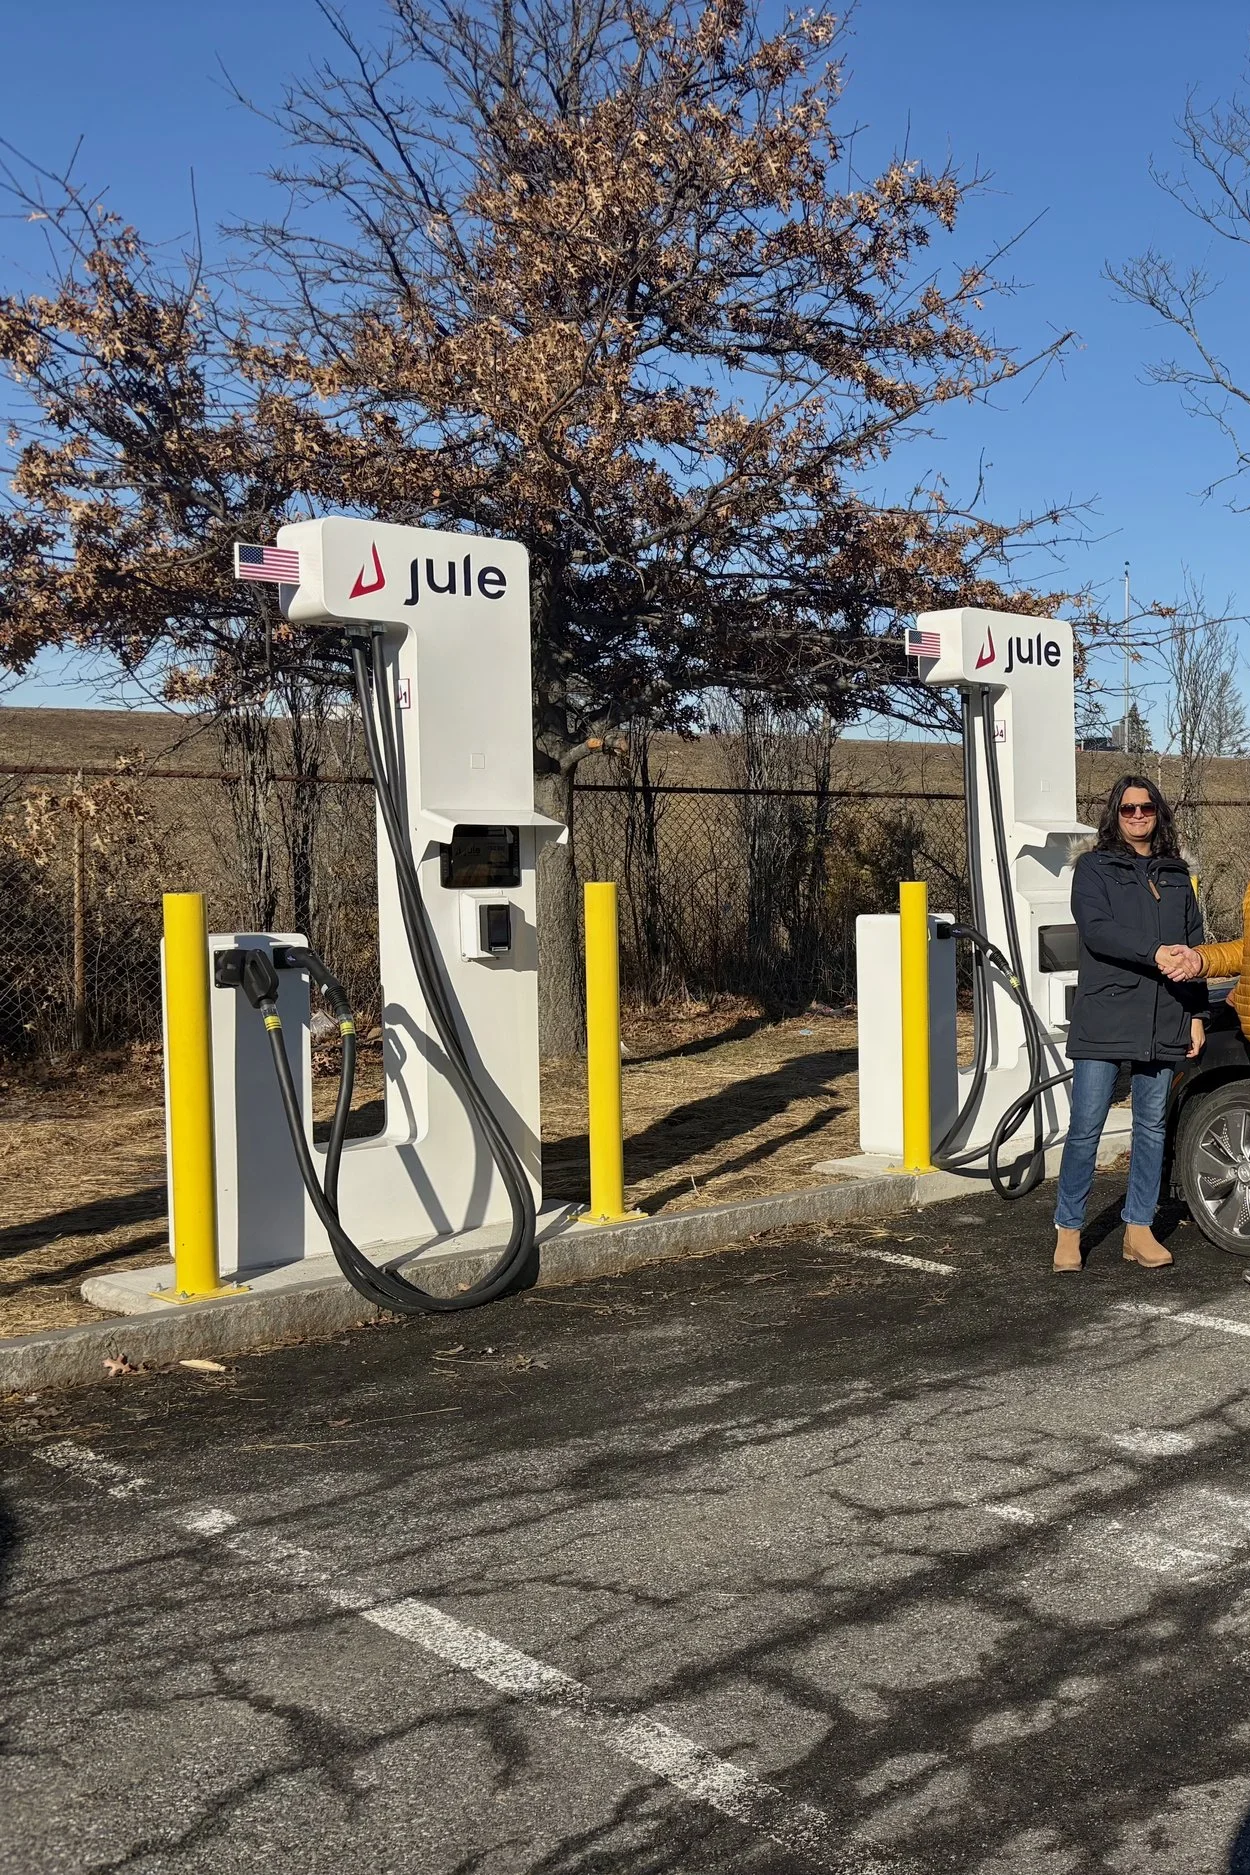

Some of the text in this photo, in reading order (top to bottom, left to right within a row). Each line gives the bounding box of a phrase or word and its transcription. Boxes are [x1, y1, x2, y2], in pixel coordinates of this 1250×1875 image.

[403, 552, 507, 606] jule
[1004, 632, 1061, 673] jule
[403, 691, 407, 703] 1
